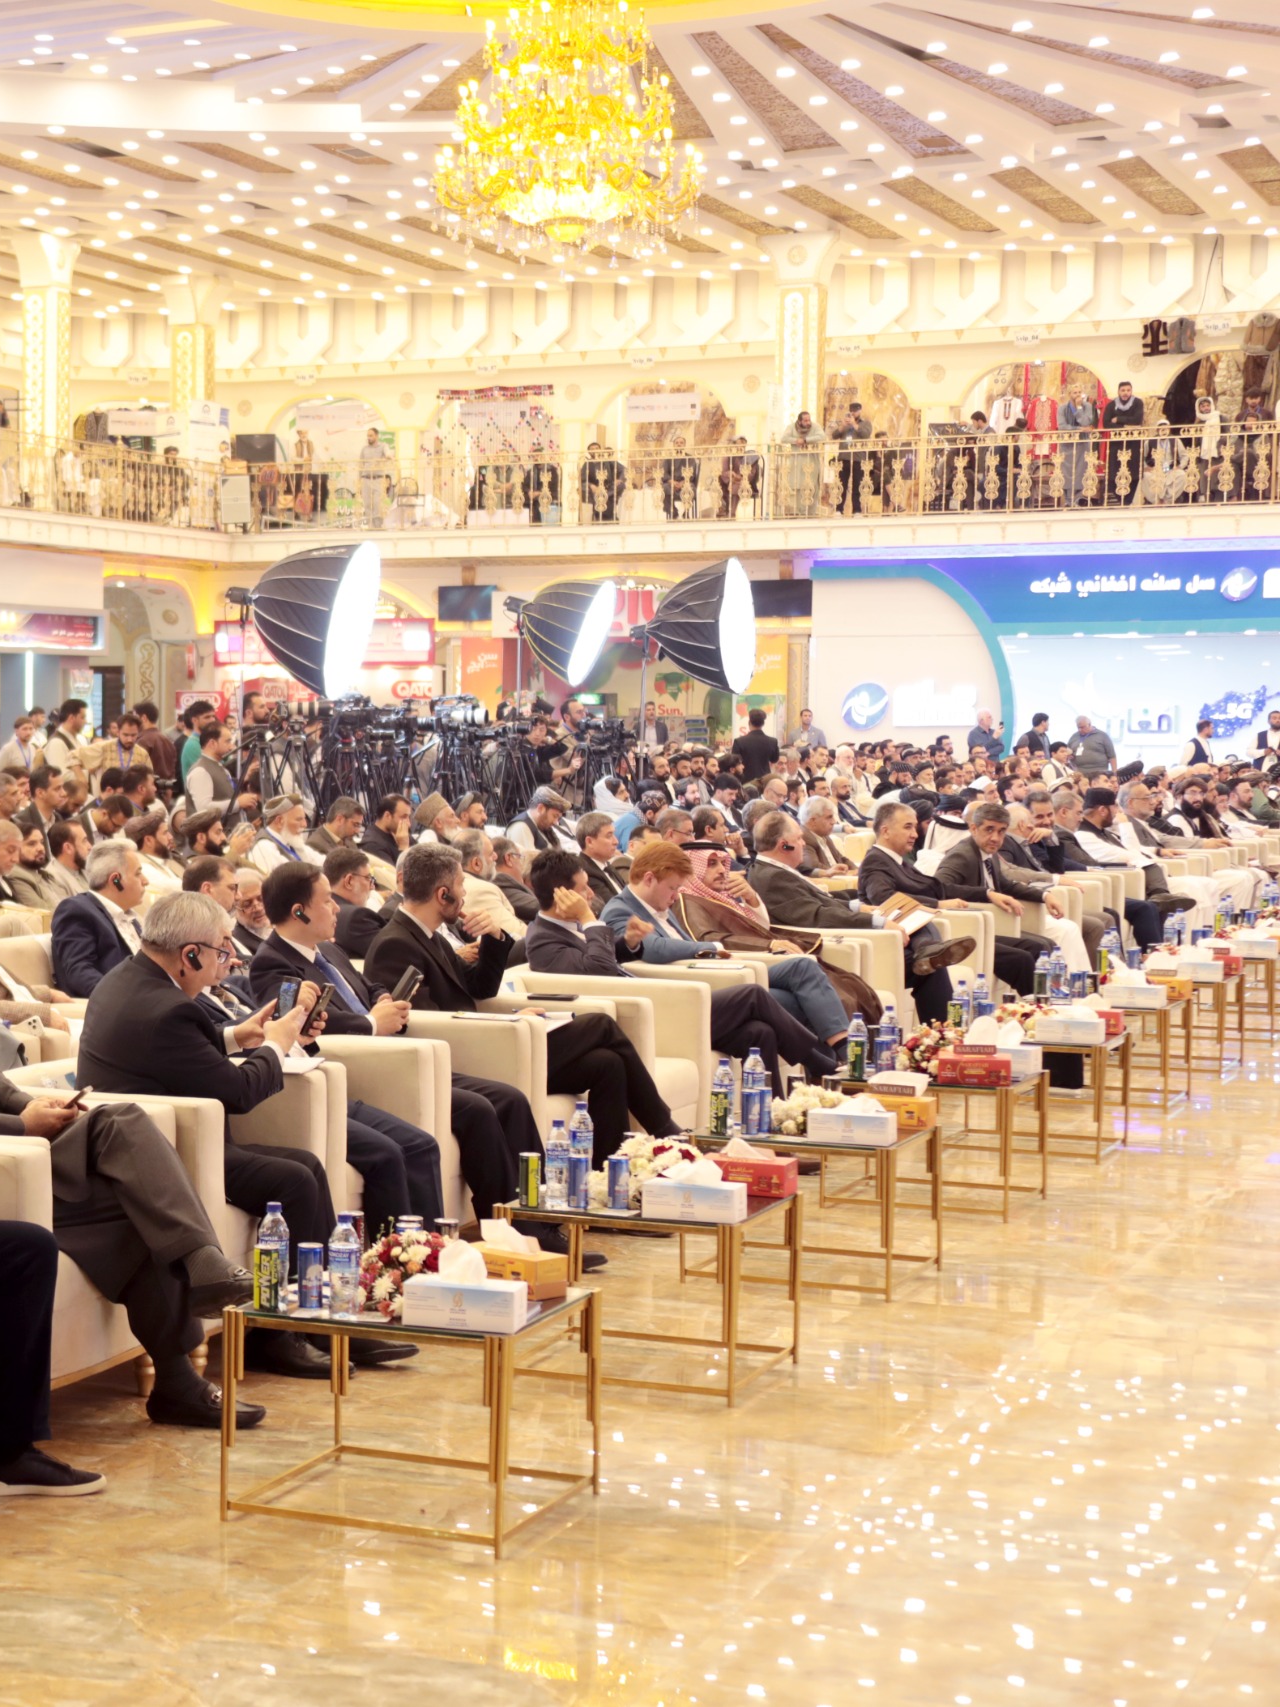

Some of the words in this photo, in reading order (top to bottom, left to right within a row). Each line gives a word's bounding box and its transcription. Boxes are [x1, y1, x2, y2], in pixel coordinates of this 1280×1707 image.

[1185, 574, 1217, 595] سل
[397, 682, 432, 697] QATO
[1226, 702, 1253, 719] 5G
[260, 1255, 271, 1308] POWER
